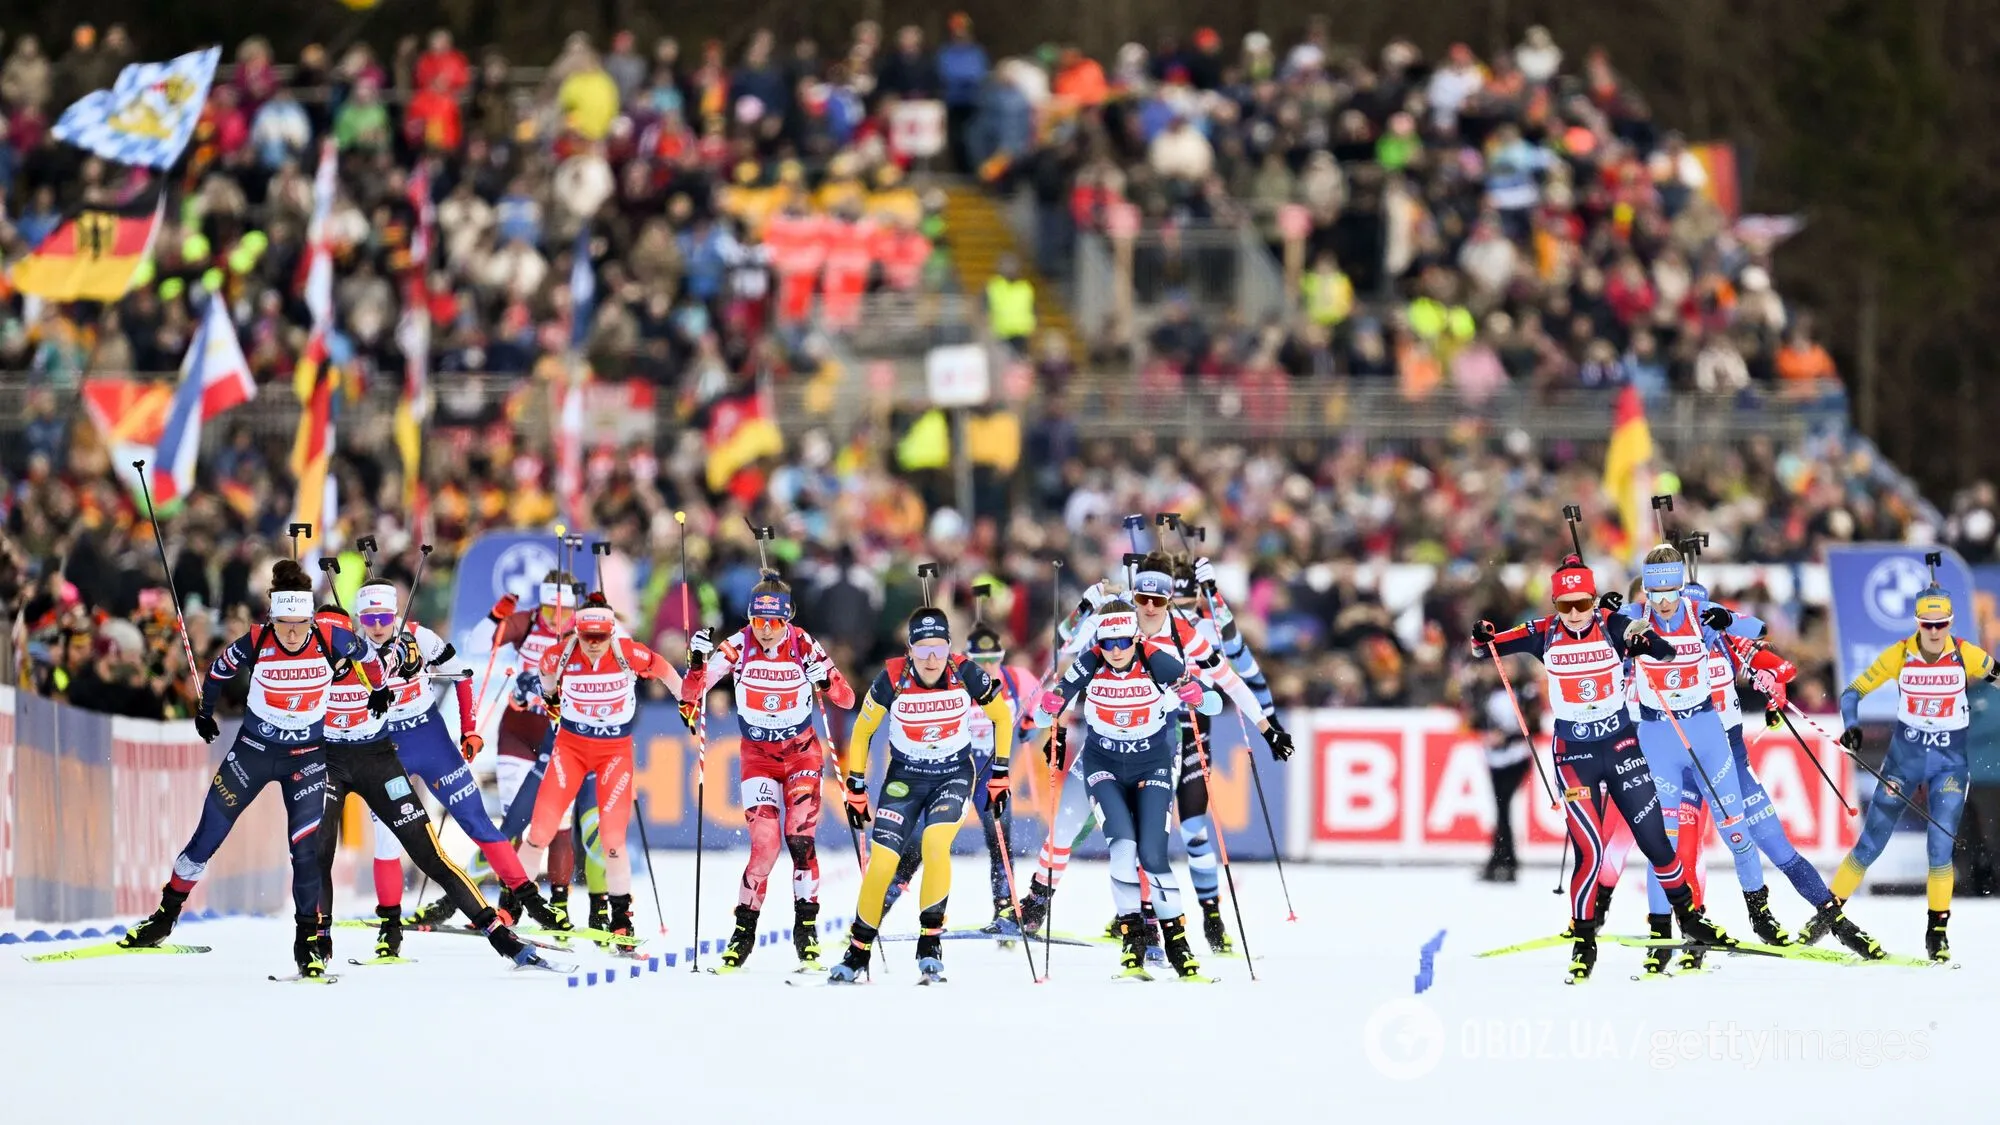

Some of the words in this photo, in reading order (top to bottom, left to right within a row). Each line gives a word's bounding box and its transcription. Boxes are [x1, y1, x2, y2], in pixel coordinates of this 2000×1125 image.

[1561, 574, 1582, 585] ice
[1098, 616, 1132, 628] AVANT
[1551, 649, 1614, 665] BAUHAUS
[262, 666, 327, 681] BAUHAUS
[744, 668, 801, 681] BAUHAUS
[1664, 668, 1682, 689] 6
[1902, 674, 1960, 685] BAUHAUS
[571, 678, 629, 693] BAUHAUS
[1092, 685, 1152, 698] BAUHAUS
[1578, 678, 1598, 701] 3
[286, 694, 303, 711] 1
[762, 694, 781, 712] 8
[899, 697, 963, 713] BAUHAUS
[1733, 698, 1740, 710] 9
[1912, 700, 1943, 716] 15
[331, 713, 349, 728] 4
[1114, 711, 1132, 727] 5
[1594, 714, 1620, 738] iX3
[768, 727, 797, 742] iX3
[921, 726, 943, 742] 2
[1922, 731, 1951, 747] iX3
[1119, 738, 1151, 754] iX3
[1562, 752, 1593, 762] LAPUA
[294, 781, 324, 801] CRAFT
[1145, 779, 1171, 790] STARK
[1634, 798, 1658, 825] CRAFT
